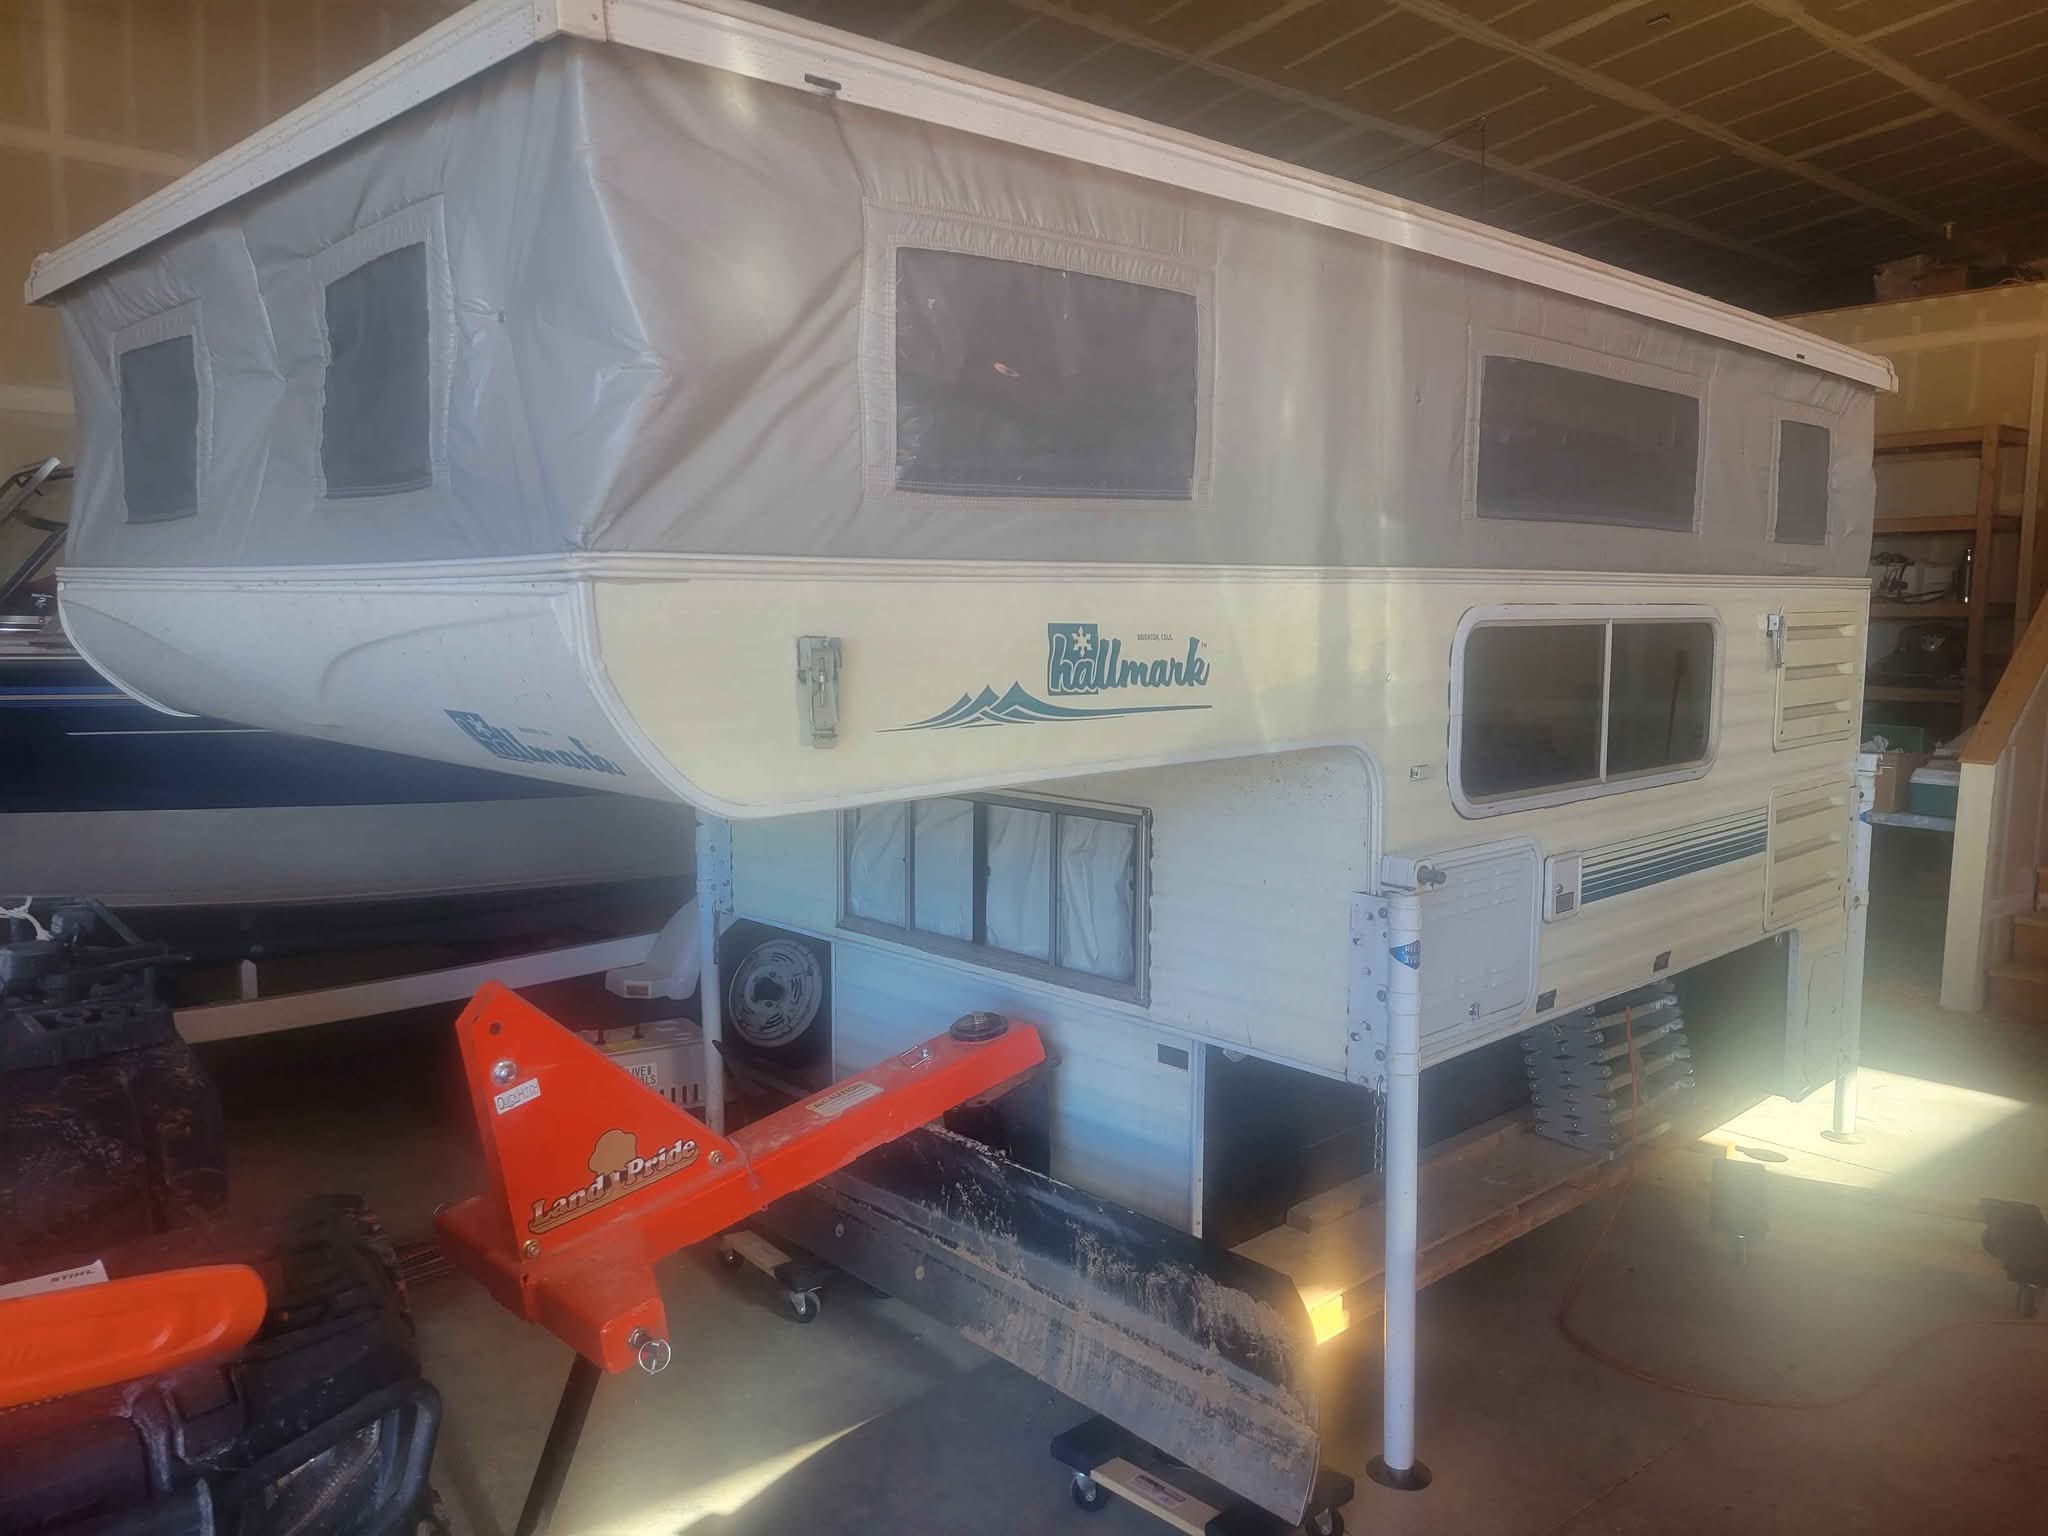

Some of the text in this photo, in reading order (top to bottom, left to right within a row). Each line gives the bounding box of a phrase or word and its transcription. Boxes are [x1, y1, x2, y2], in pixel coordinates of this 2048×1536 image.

[1050, 634, 1210, 691] hallmark
[530, 1138, 697, 1229] Land Pride
[50, 1269, 96, 1283] STIHL
